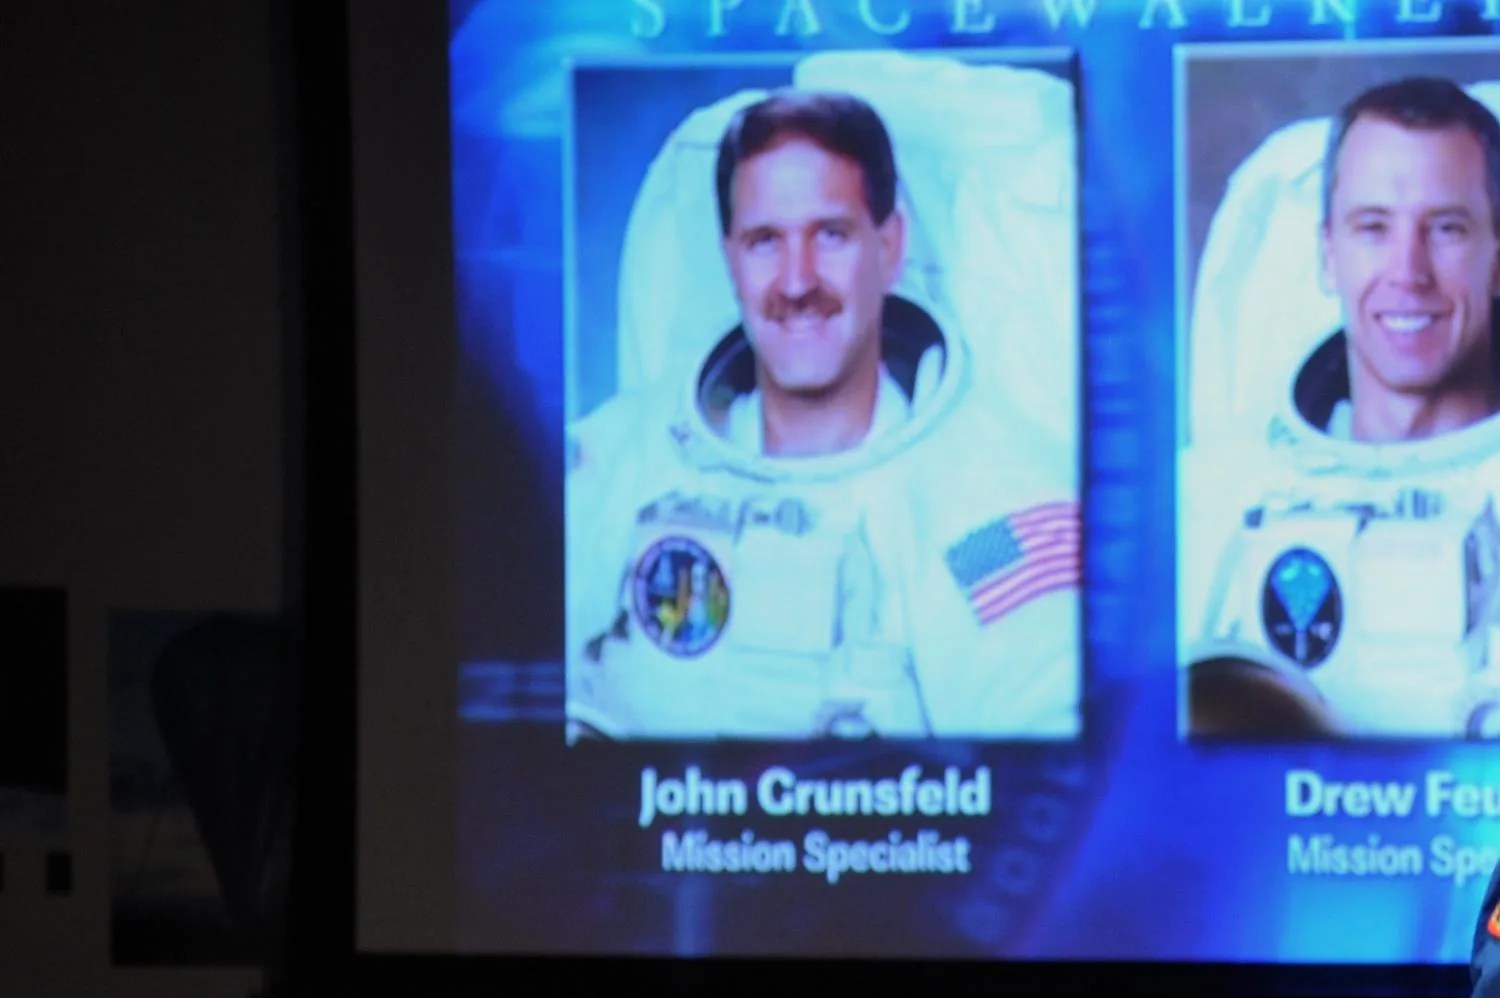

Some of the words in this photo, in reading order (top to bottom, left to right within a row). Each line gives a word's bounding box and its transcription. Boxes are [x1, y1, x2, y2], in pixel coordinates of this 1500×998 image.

[639, 765, 748, 828] John
[1285, 769, 1416, 818] Drew
[661, 829, 797, 873] Mission
[802, 829, 972, 884] Specialist
[1287, 832, 1423, 876] Mission
